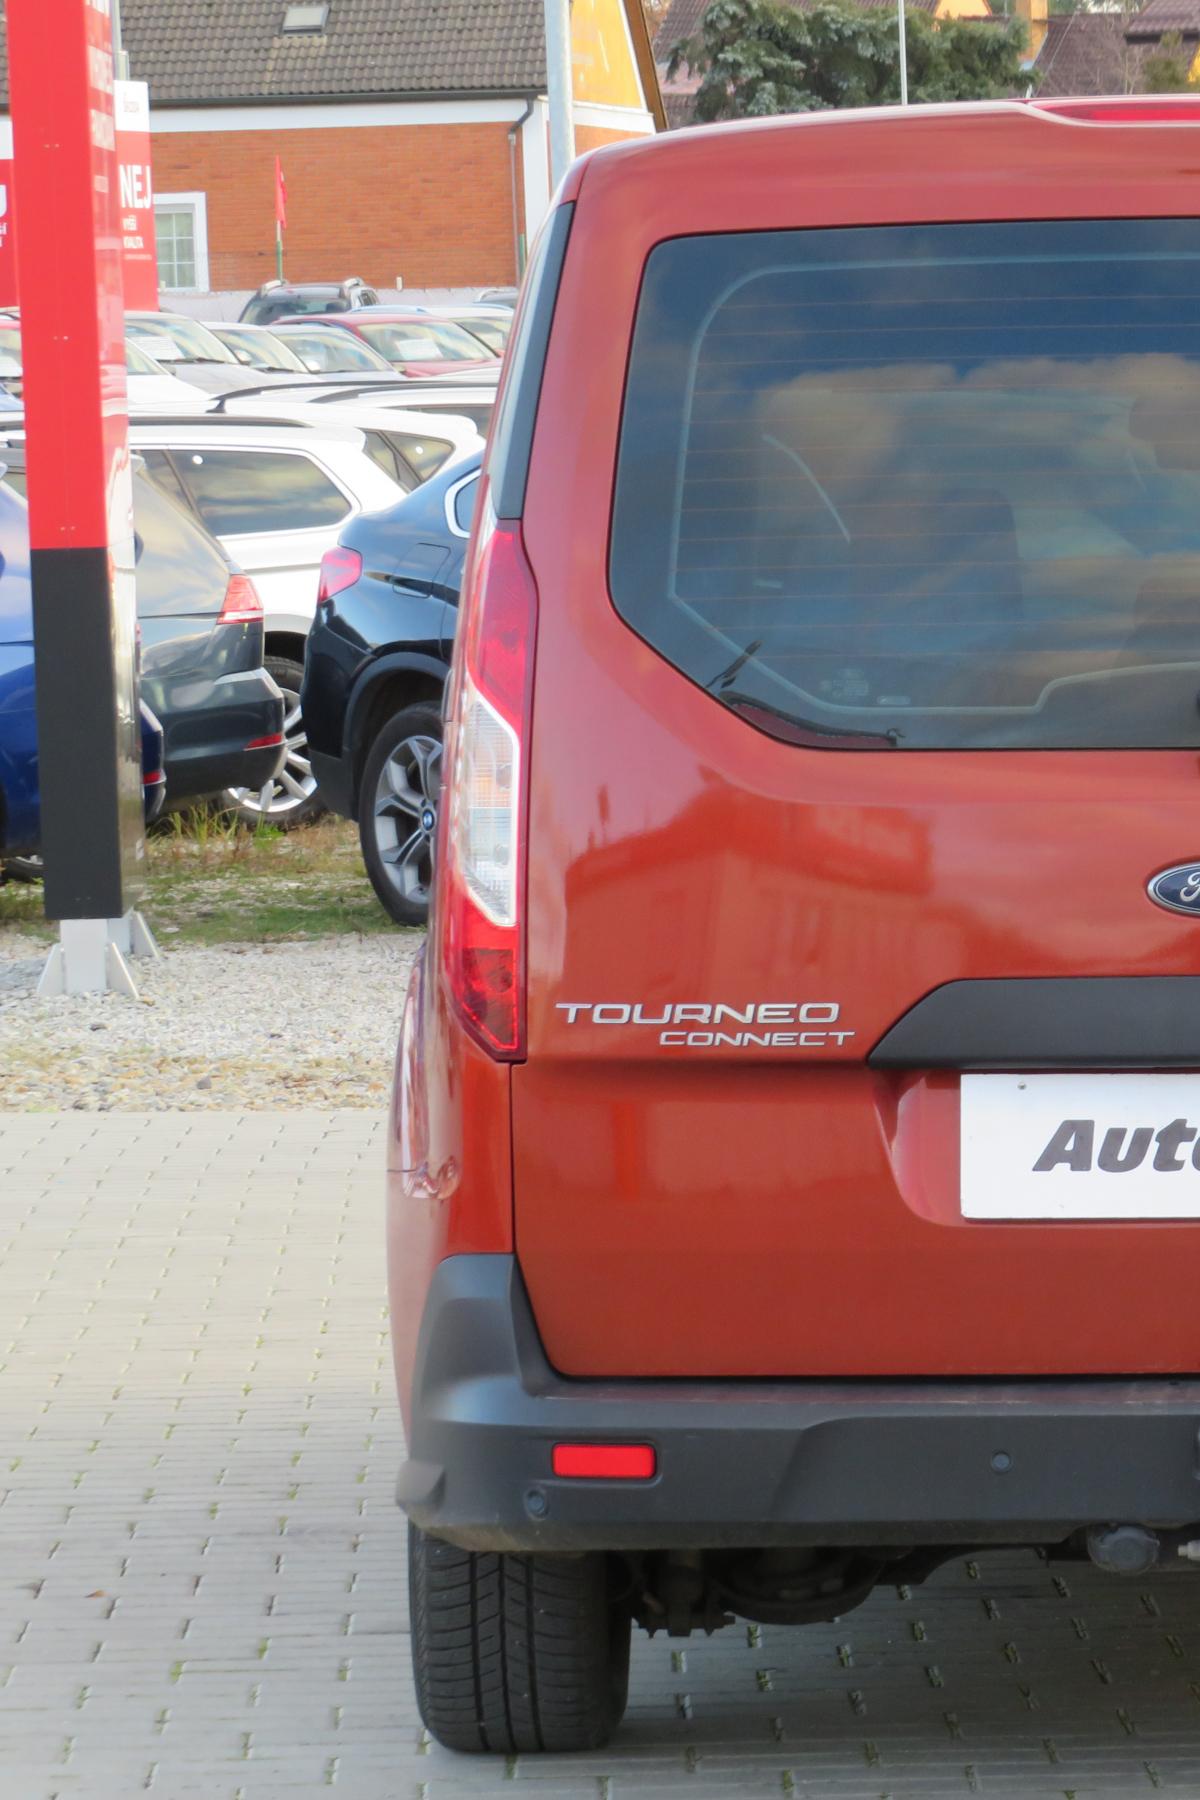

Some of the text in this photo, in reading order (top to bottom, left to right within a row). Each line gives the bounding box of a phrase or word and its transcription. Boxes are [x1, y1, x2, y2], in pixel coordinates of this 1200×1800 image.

[118, 164, 152, 209] NEJ
[555, 1002, 840, 1024] TOURNEO
[659, 1031, 856, 1046] CONNECT
